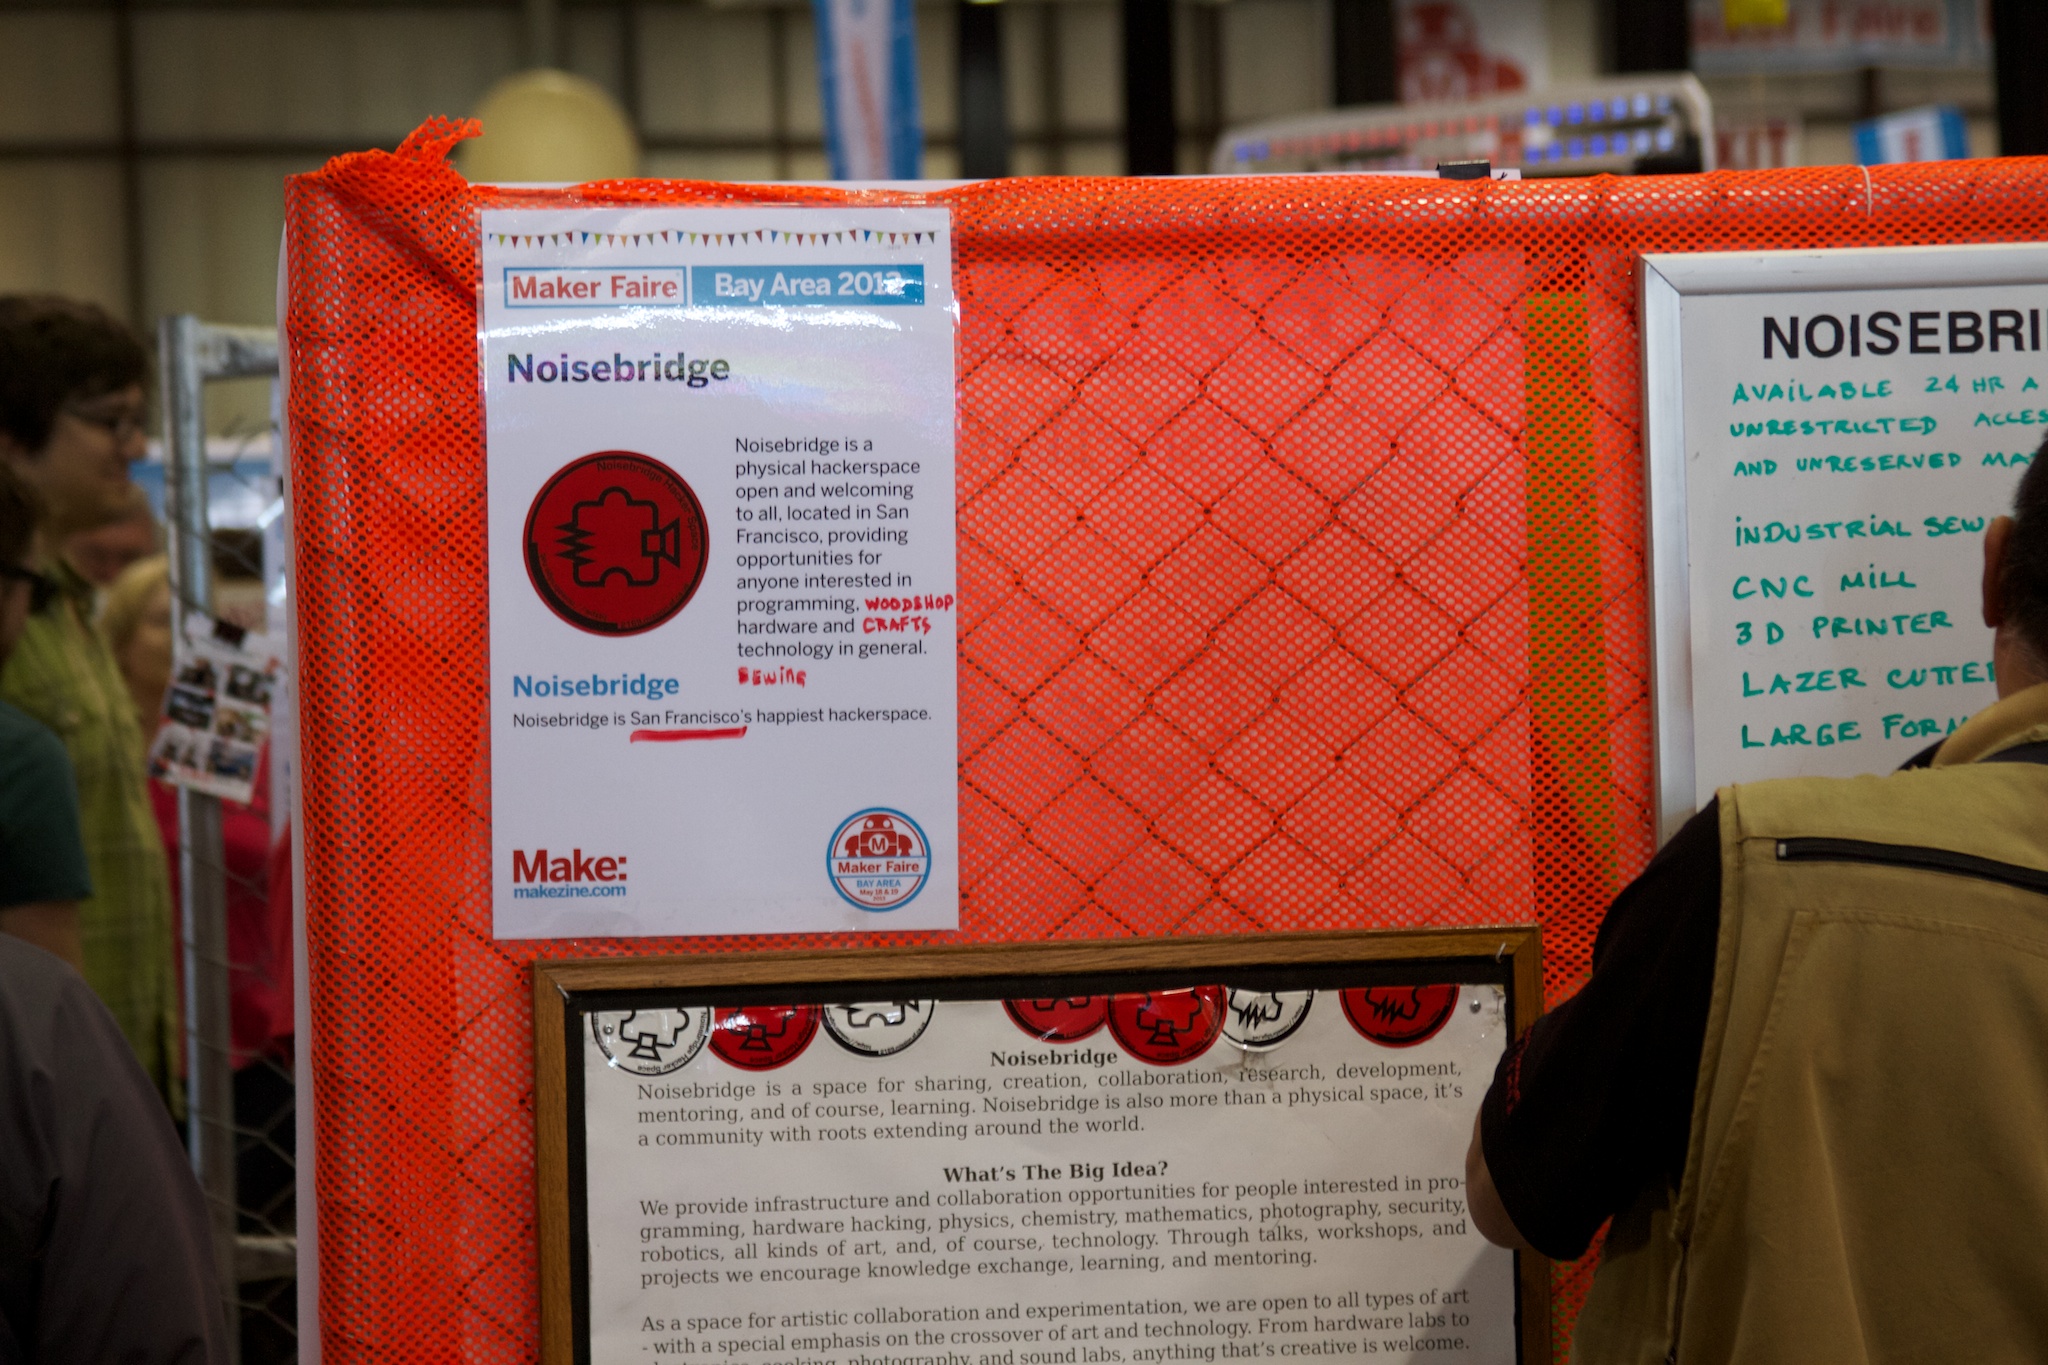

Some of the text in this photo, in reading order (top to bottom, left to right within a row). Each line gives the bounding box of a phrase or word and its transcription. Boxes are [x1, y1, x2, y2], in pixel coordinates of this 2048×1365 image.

[512, 276, 600, 299] Maker
[610, 275, 677, 298] Faire
[715, 274, 764, 301] Bay
[770, 273, 830, 297] Area
[1763, 309, 2048, 359] NOISEBRI
[507, 353, 730, 389] Noisebridge
[1925, 375, 1959, 393] 24
[1972, 376, 2004, 393] HR
[1730, 416, 1937, 437] UNRESTRICTED
[736, 436, 872, 456] Noisebridge is a
[736, 459, 920, 480] physical hackerspace
[1734, 452, 2037, 476] AND UNRESERVED MA
[736, 482, 914, 502] open and welcoming
[596, 461, 698, 551] Noisebridge Hacker Space
[736, 504, 908, 522] to all, located in San
[737, 527, 908, 546] Francisco, providing
[1924, 516, 1992, 538] SEW
[736, 550, 882, 570] opportunities for
[737, 572, 912, 593] anyone interested in
[1732, 575, 1814, 600] CNC
[737, 596, 859, 616] programming,
[864, 593, 954, 613] WOODSHOP
[738, 618, 854, 634] hardware and
[862, 615, 931, 635] CRAFTS
[1812, 611, 1952, 638] PRINTER
[737, 639, 927, 660] technology in general.
[513, 672, 680, 701] Noisebridge
[1742, 668, 1866, 698] LAZER
[514, 708, 931, 729] Noisebridge is San Francisco's happiest hackerspace.
[1742, 722, 1861, 749] LARGE
[513, 848, 627, 883] Make:
[838, 861, 919, 873] Maker Faire
[514, 884, 627, 898] makezine.com
[857, 879, 901, 888] BAY AREA
[990, 1048, 1118, 1068] Noisebridge
[638, 1061, 1461, 1101] Noisebridge is a space for sharing, creation, collaboration, research, development,
[638, 1115, 1144, 1147] a community with roots extending around the world.
[942, 1160, 1168, 1183] What's The Big Idea?
[639, 1175, 1467, 1219] We provide infrastructure and collaboration opportunities for people interested in pro-
[640, 1197, 1466, 1243] gramming, hardware hacking, physics, chemistry, mathematics, photography, security,
[641, 1249, 1317, 1289] projects we encourage knowledge exchange, learning, and mentoring.
[641, 1288, 1470, 1334] As a space for artistic collaboration and experimentation, we are open to all types of art
